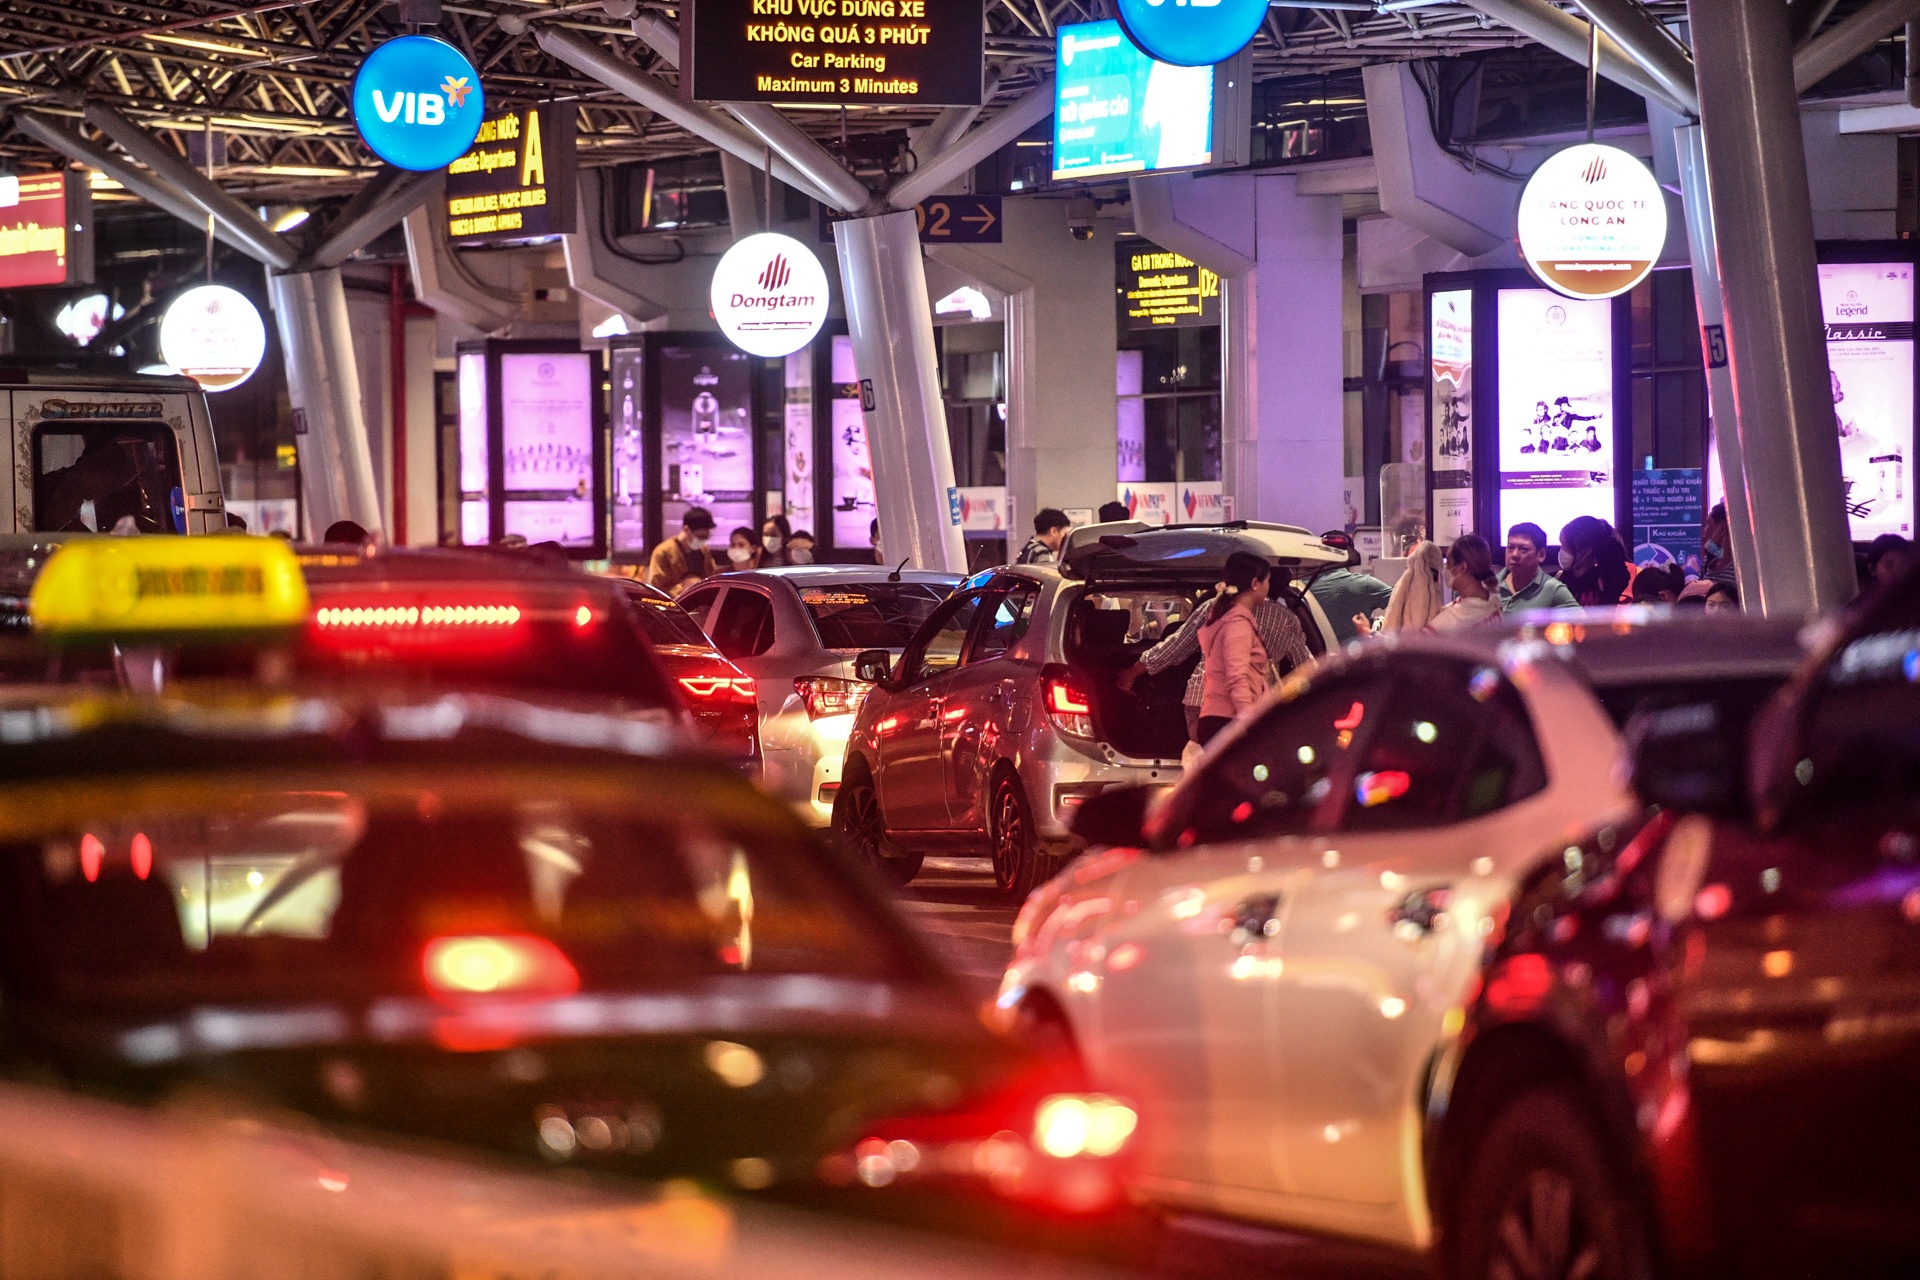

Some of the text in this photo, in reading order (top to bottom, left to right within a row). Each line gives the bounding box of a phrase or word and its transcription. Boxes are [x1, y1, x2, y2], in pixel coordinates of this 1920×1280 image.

[753, 0, 792, 15] KHU
[899, 1, 926, 17] XE
[747, 22, 931, 45] KHÔNG QUÁ 3 PHÚT
[791, 53, 886, 73] Car Parking
[758, 77, 919, 94] Maximum 3 Minutes
[372, 89, 446, 125] VIB
[522, 110, 544, 186] A
[1606, 216, 1626, 226] AN
[1200, 268, 1218, 298] D2
[730, 293, 815, 311] Dongtam
[1836, 305, 1868, 317] Legend
[41, 399, 163, 419] SPRINTER
